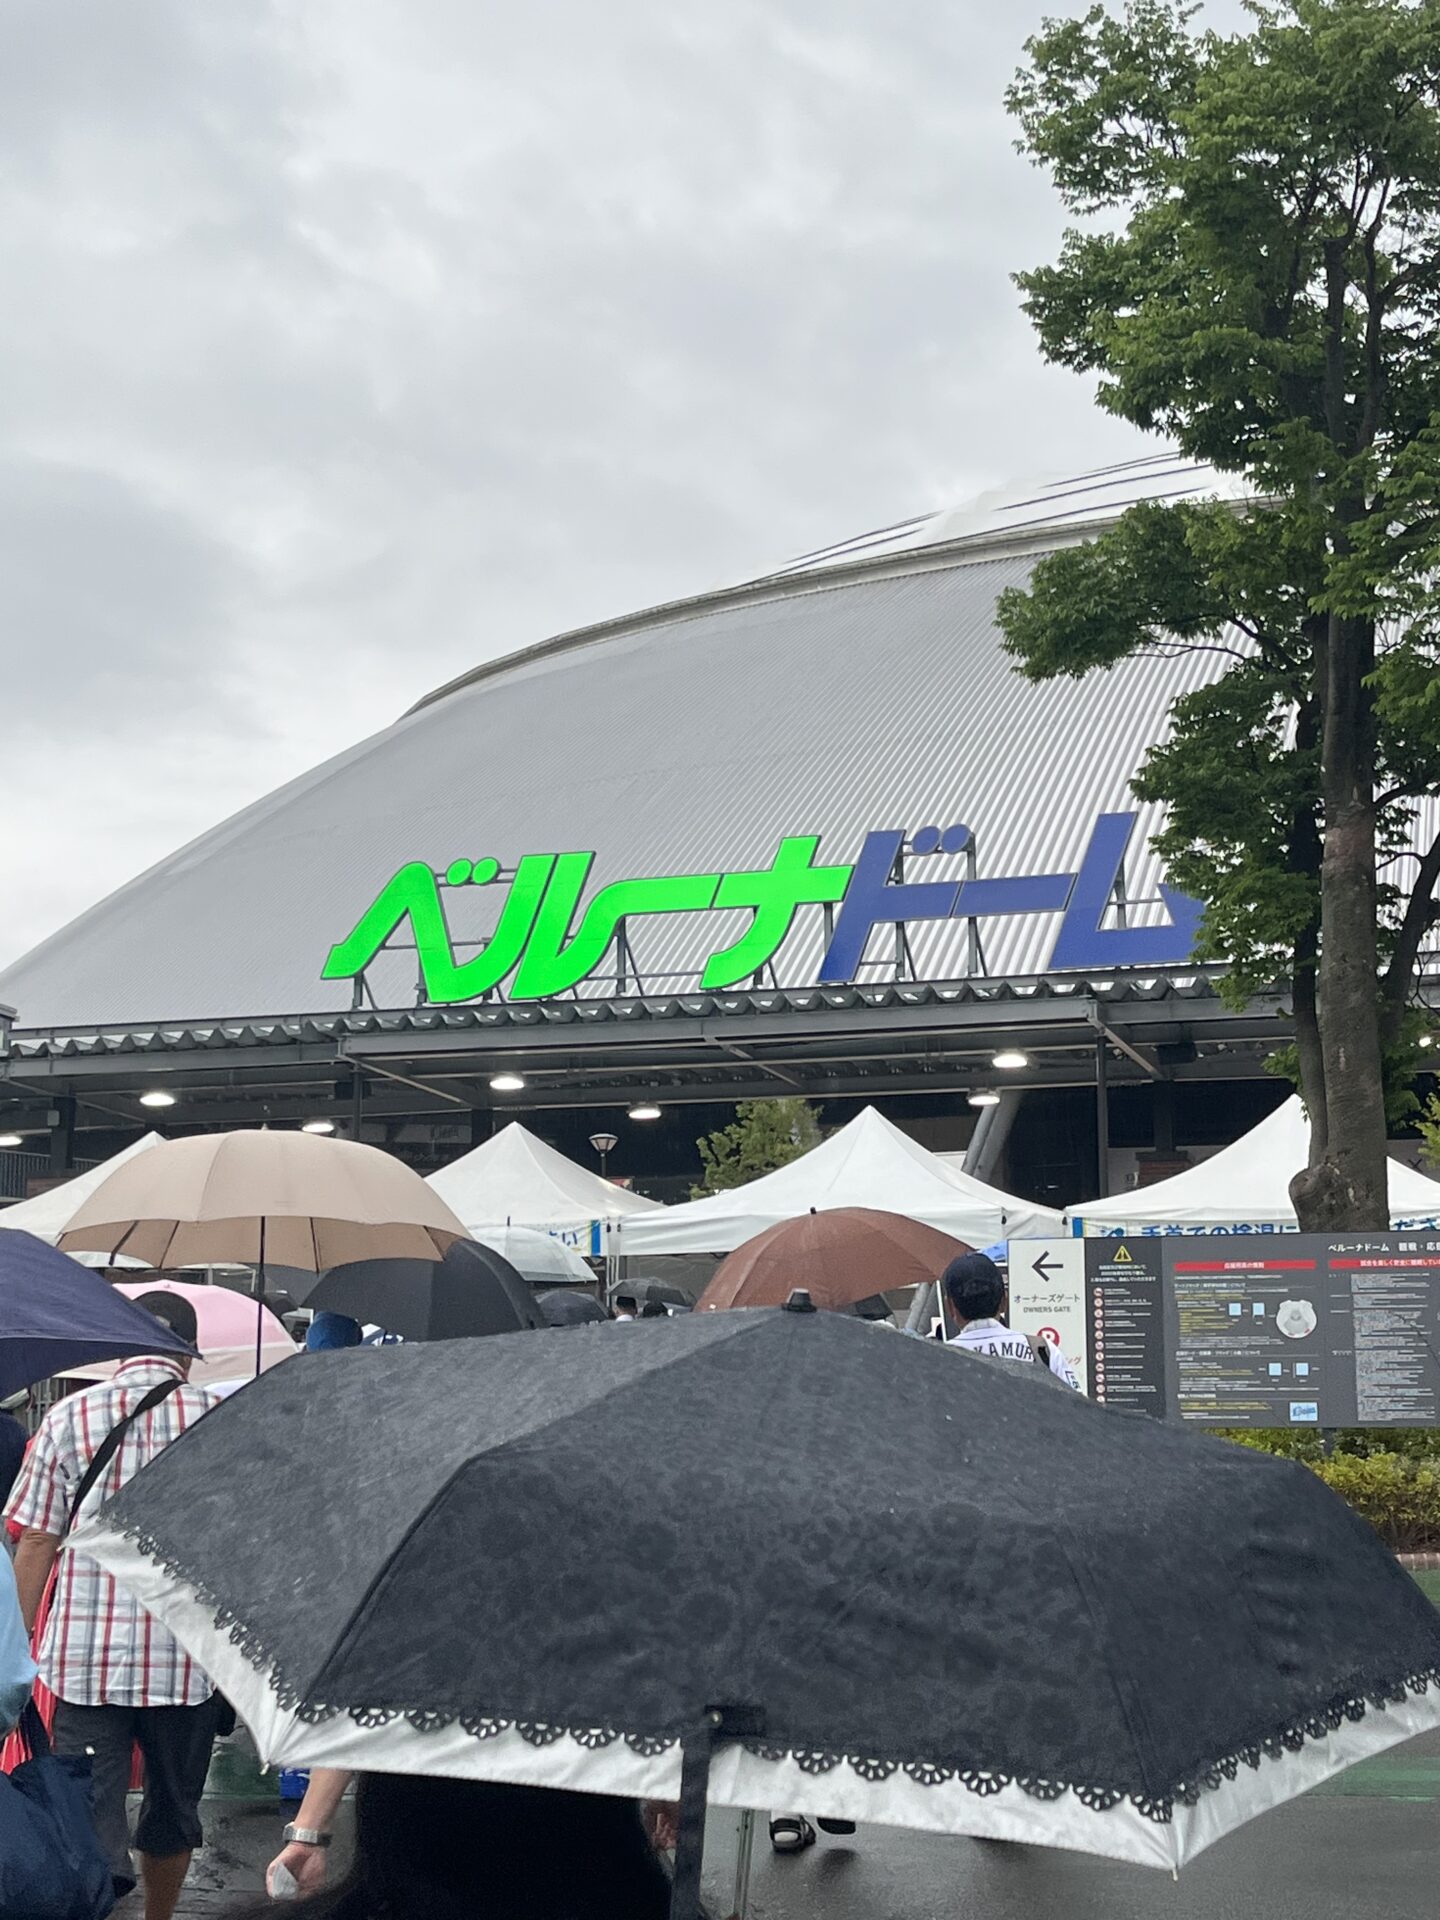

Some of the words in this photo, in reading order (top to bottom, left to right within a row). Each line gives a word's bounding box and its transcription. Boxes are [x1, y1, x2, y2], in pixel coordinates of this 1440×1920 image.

[322, 811, 1204, 1002] ベルーナドーム
[1014, 1293, 1080, 1303] オーナーズゲート
